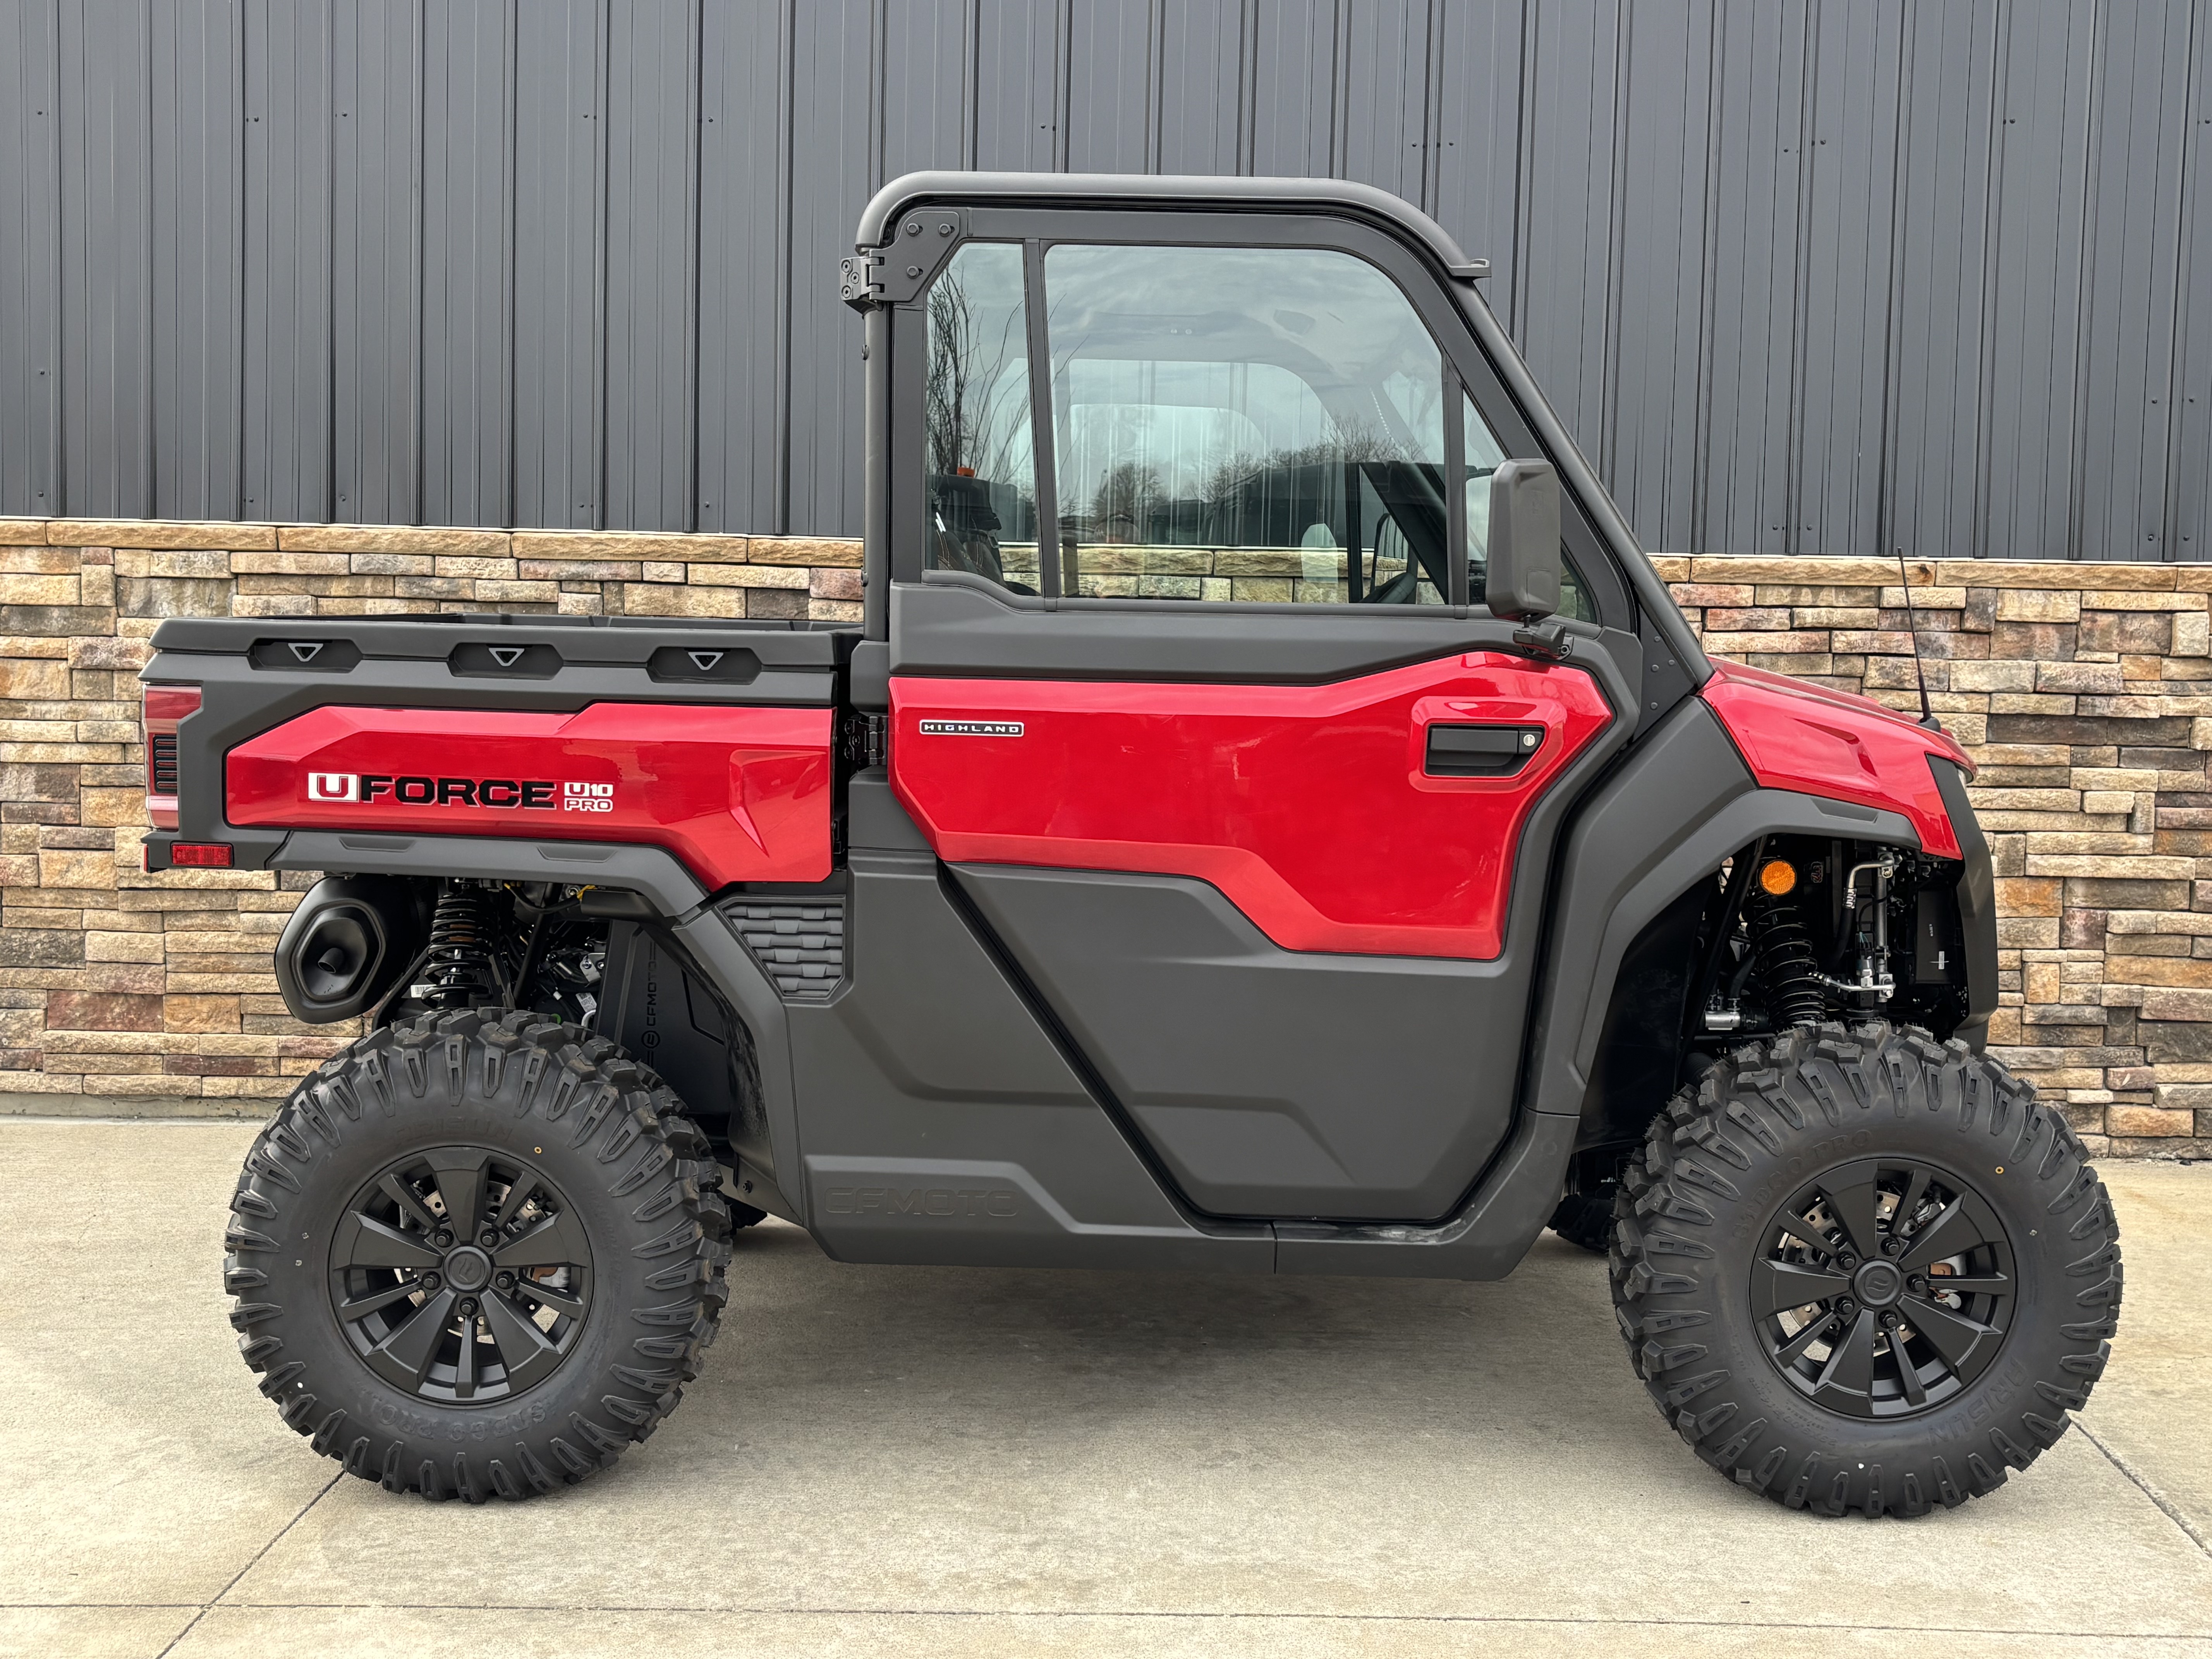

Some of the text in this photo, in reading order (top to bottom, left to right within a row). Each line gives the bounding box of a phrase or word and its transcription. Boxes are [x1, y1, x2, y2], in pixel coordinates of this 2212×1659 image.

[924, 724, 1019, 732] HIGHLAND
[565, 782, 613, 797] U10
[565, 798, 613, 812] PRO
[647, 961, 657, 1026] CFMOTO
[825, 1187, 1018, 1216] CFMOTO
[1929, 1356, 2029, 1447] ARISUN
